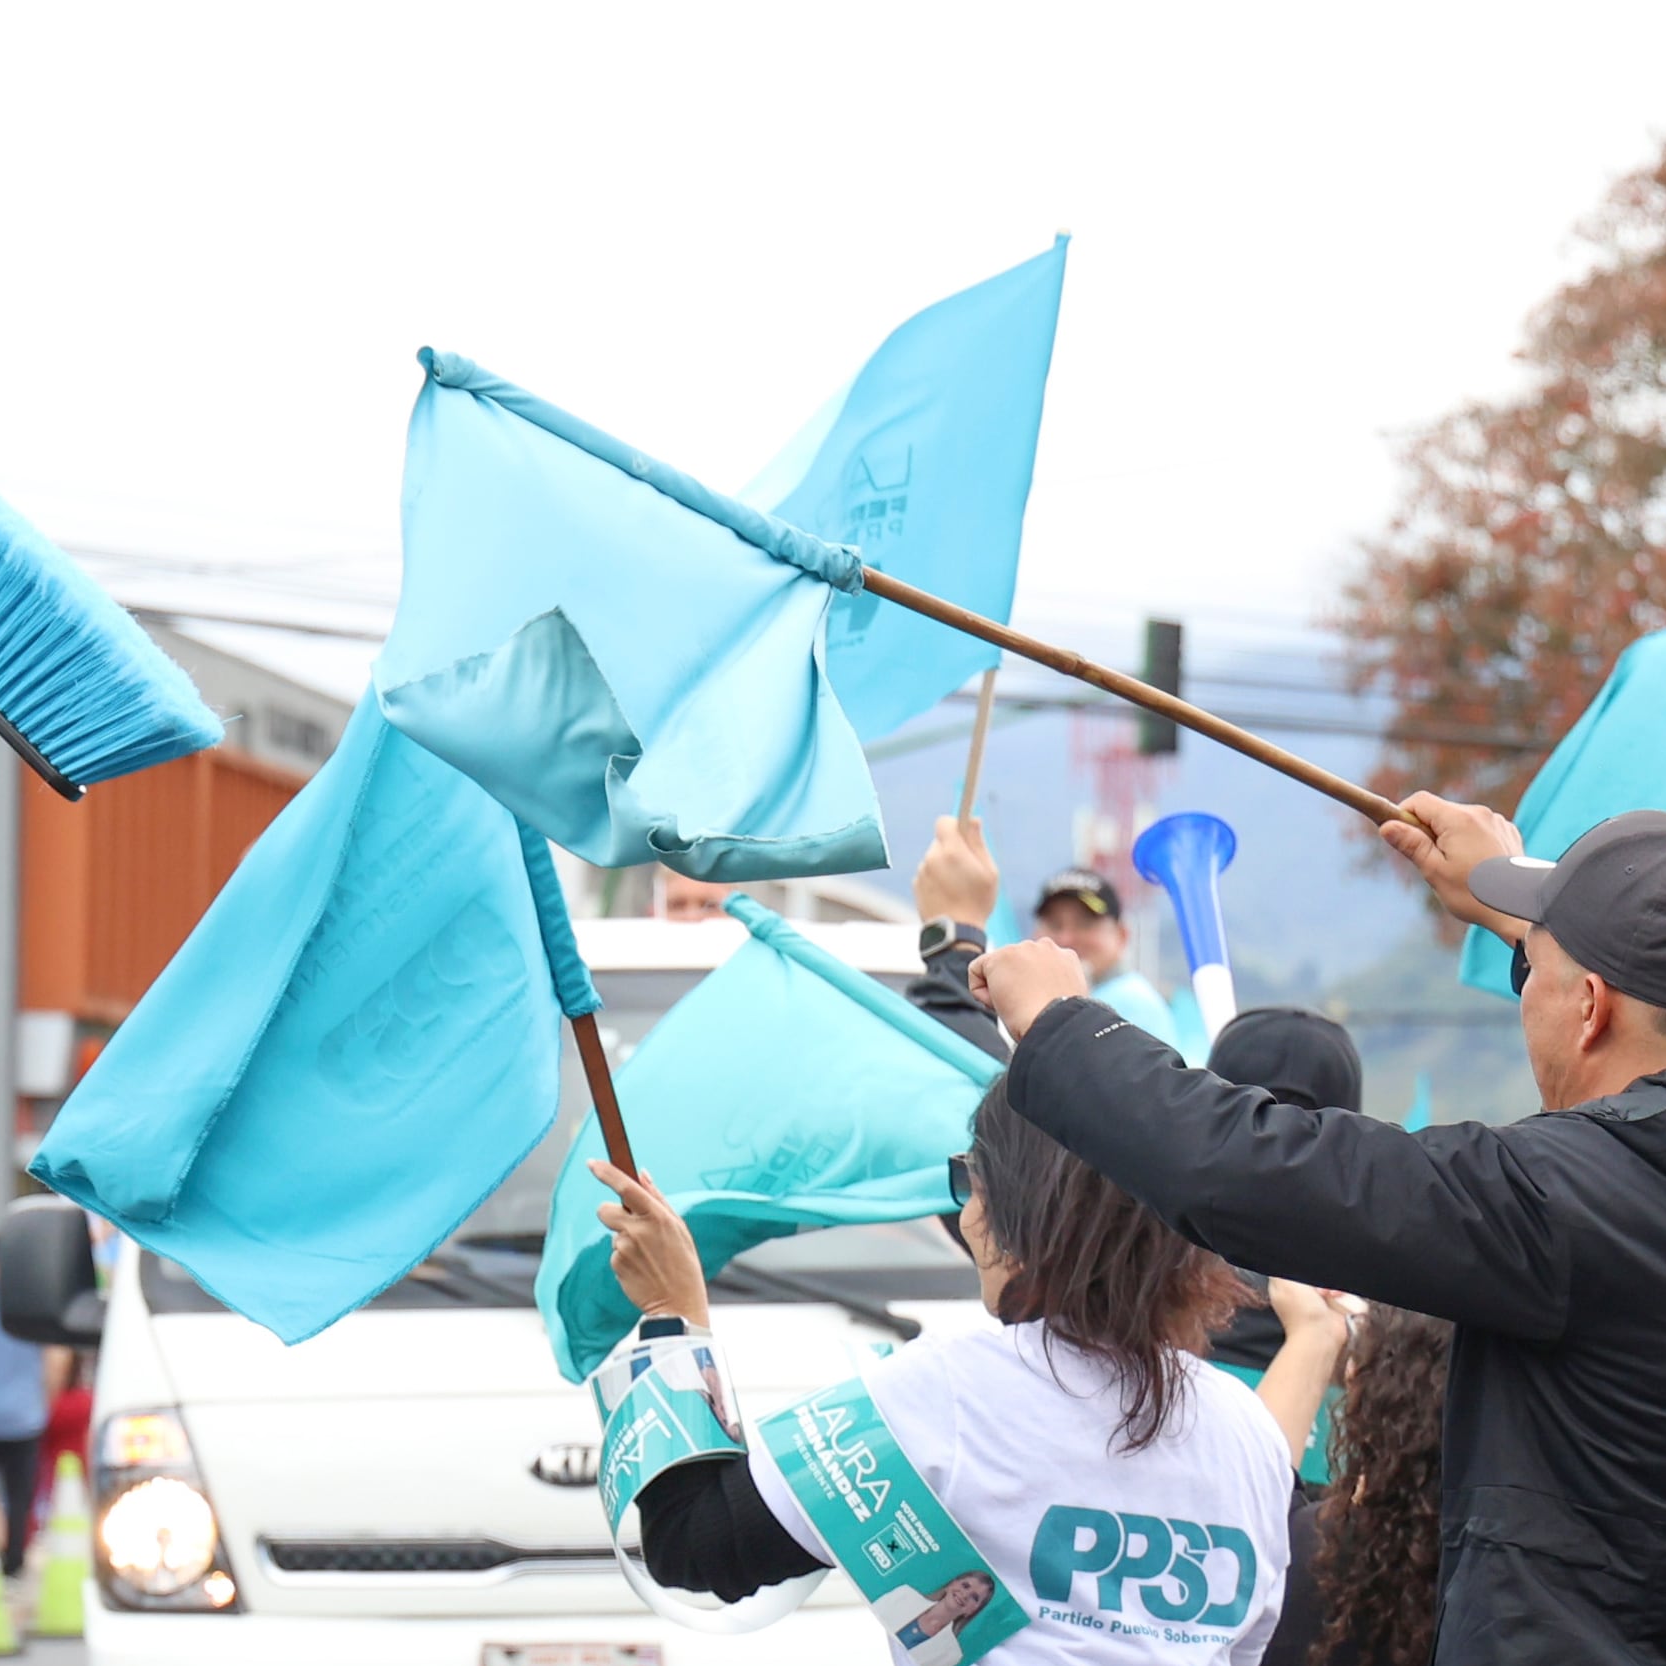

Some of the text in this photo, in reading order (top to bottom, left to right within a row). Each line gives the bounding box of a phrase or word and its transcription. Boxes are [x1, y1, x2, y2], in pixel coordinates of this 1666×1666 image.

[791, 1433, 837, 1501] PRESIDENTE
[792, 1404, 873, 1524] FERNÁNDEZ
[809, 1388, 892, 1513] LAURA
[1039, 1606, 1104, 1630] Partido
[1110, 1620, 1159, 1639] Pueblo
